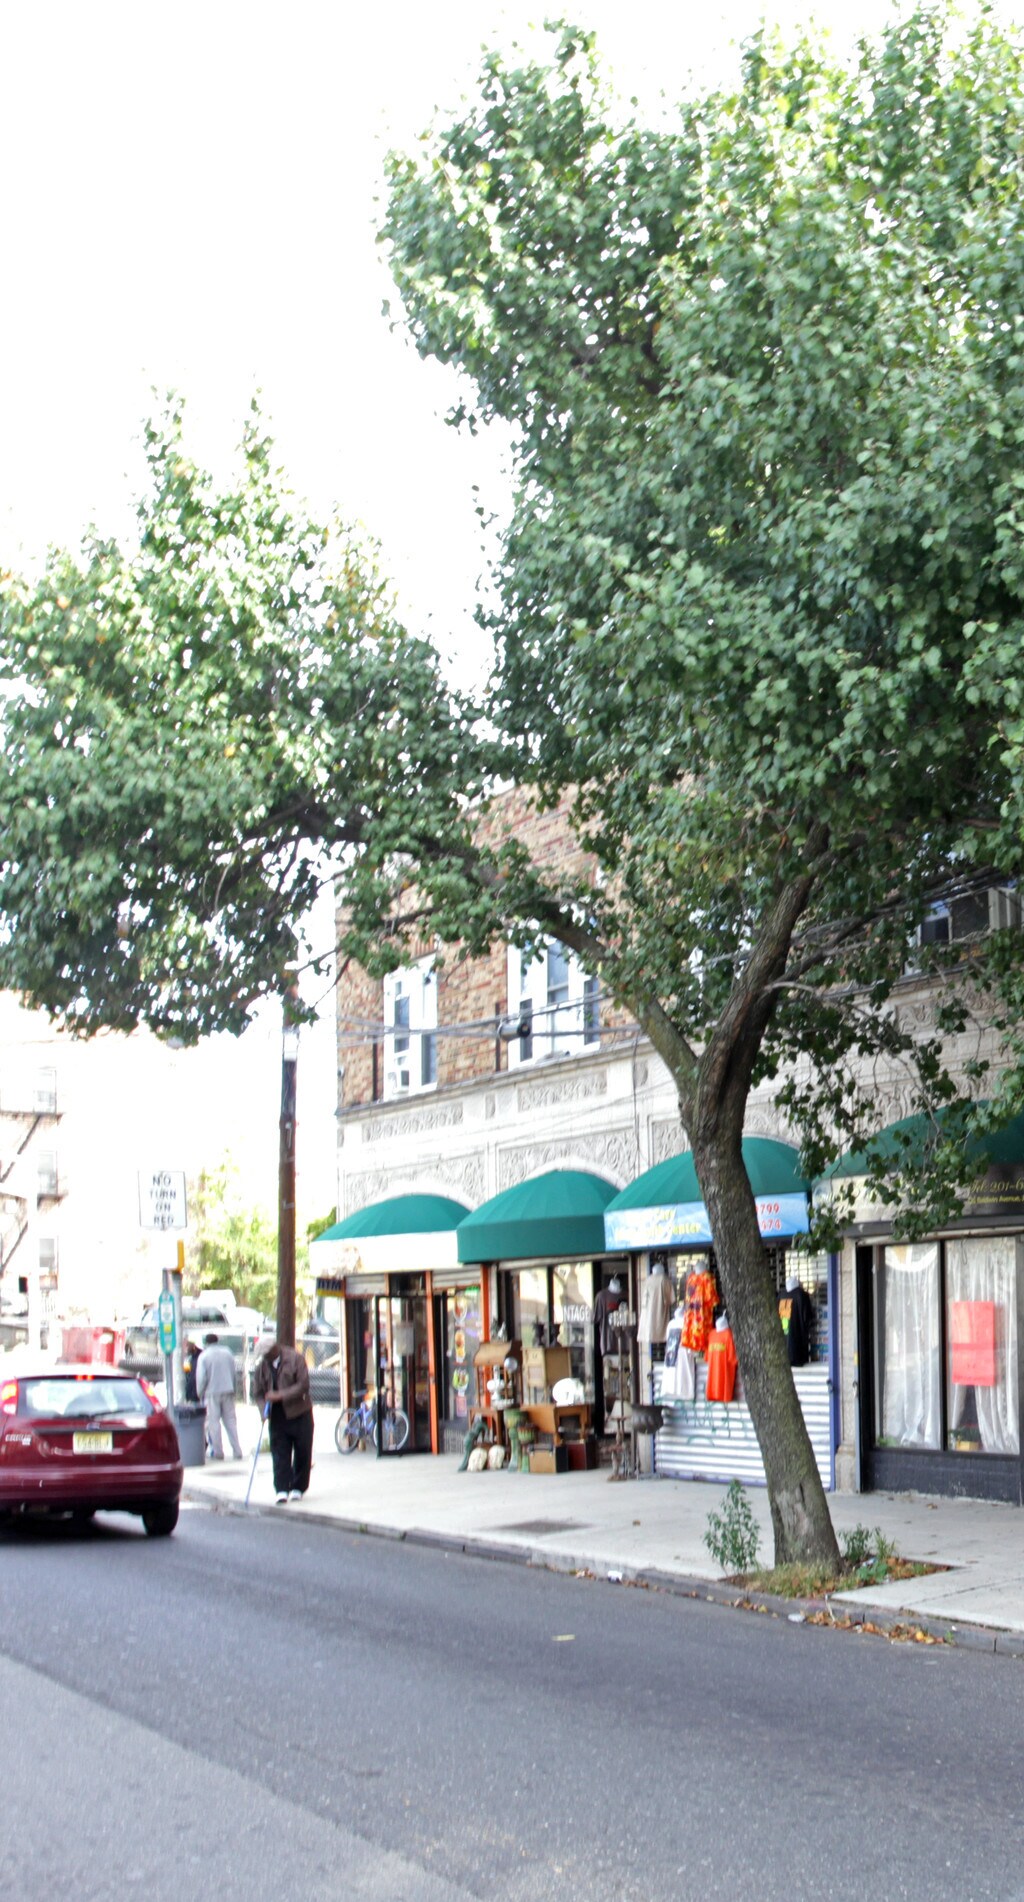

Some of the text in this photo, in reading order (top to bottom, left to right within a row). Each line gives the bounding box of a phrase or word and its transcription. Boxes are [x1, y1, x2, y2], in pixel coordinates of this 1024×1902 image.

[152, 1173, 171, 1187] NO
[149, 1188, 176, 1200] TURN
[155, 1201, 170, 1212] ON
[153, 1214, 174, 1226] RED
